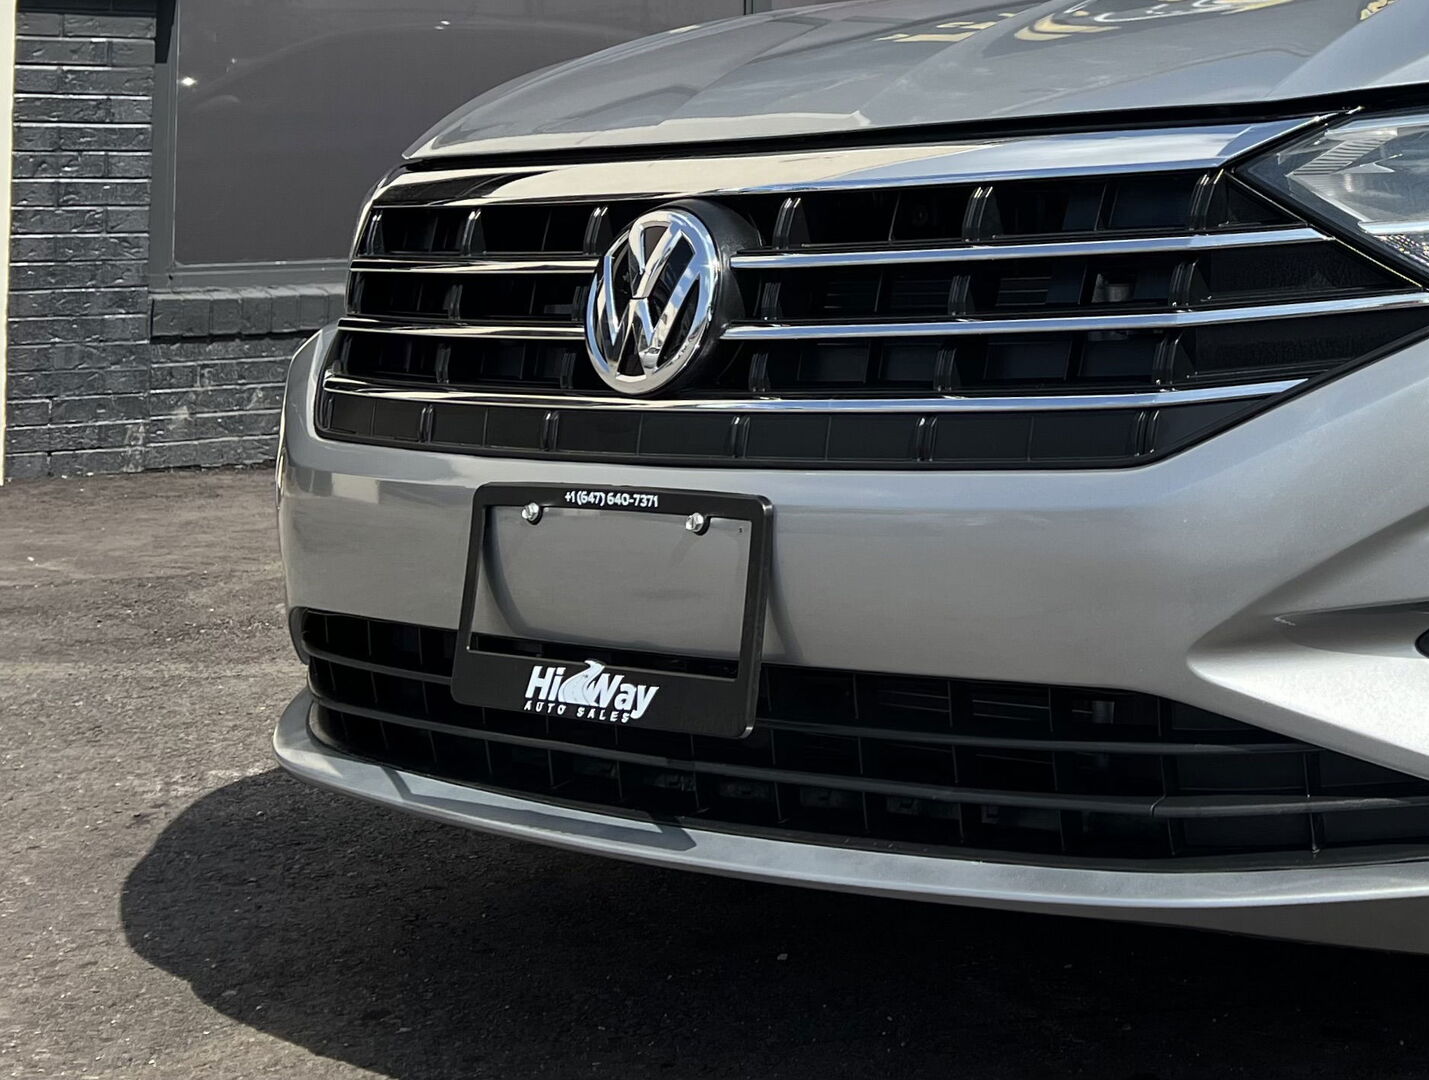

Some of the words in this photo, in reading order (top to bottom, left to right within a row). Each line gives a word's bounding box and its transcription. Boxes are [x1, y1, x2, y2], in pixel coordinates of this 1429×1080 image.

[606, 492, 659, 508] 640-7371
[523, 699, 566, 716] AUTO
[576, 705, 631, 724] SALES
